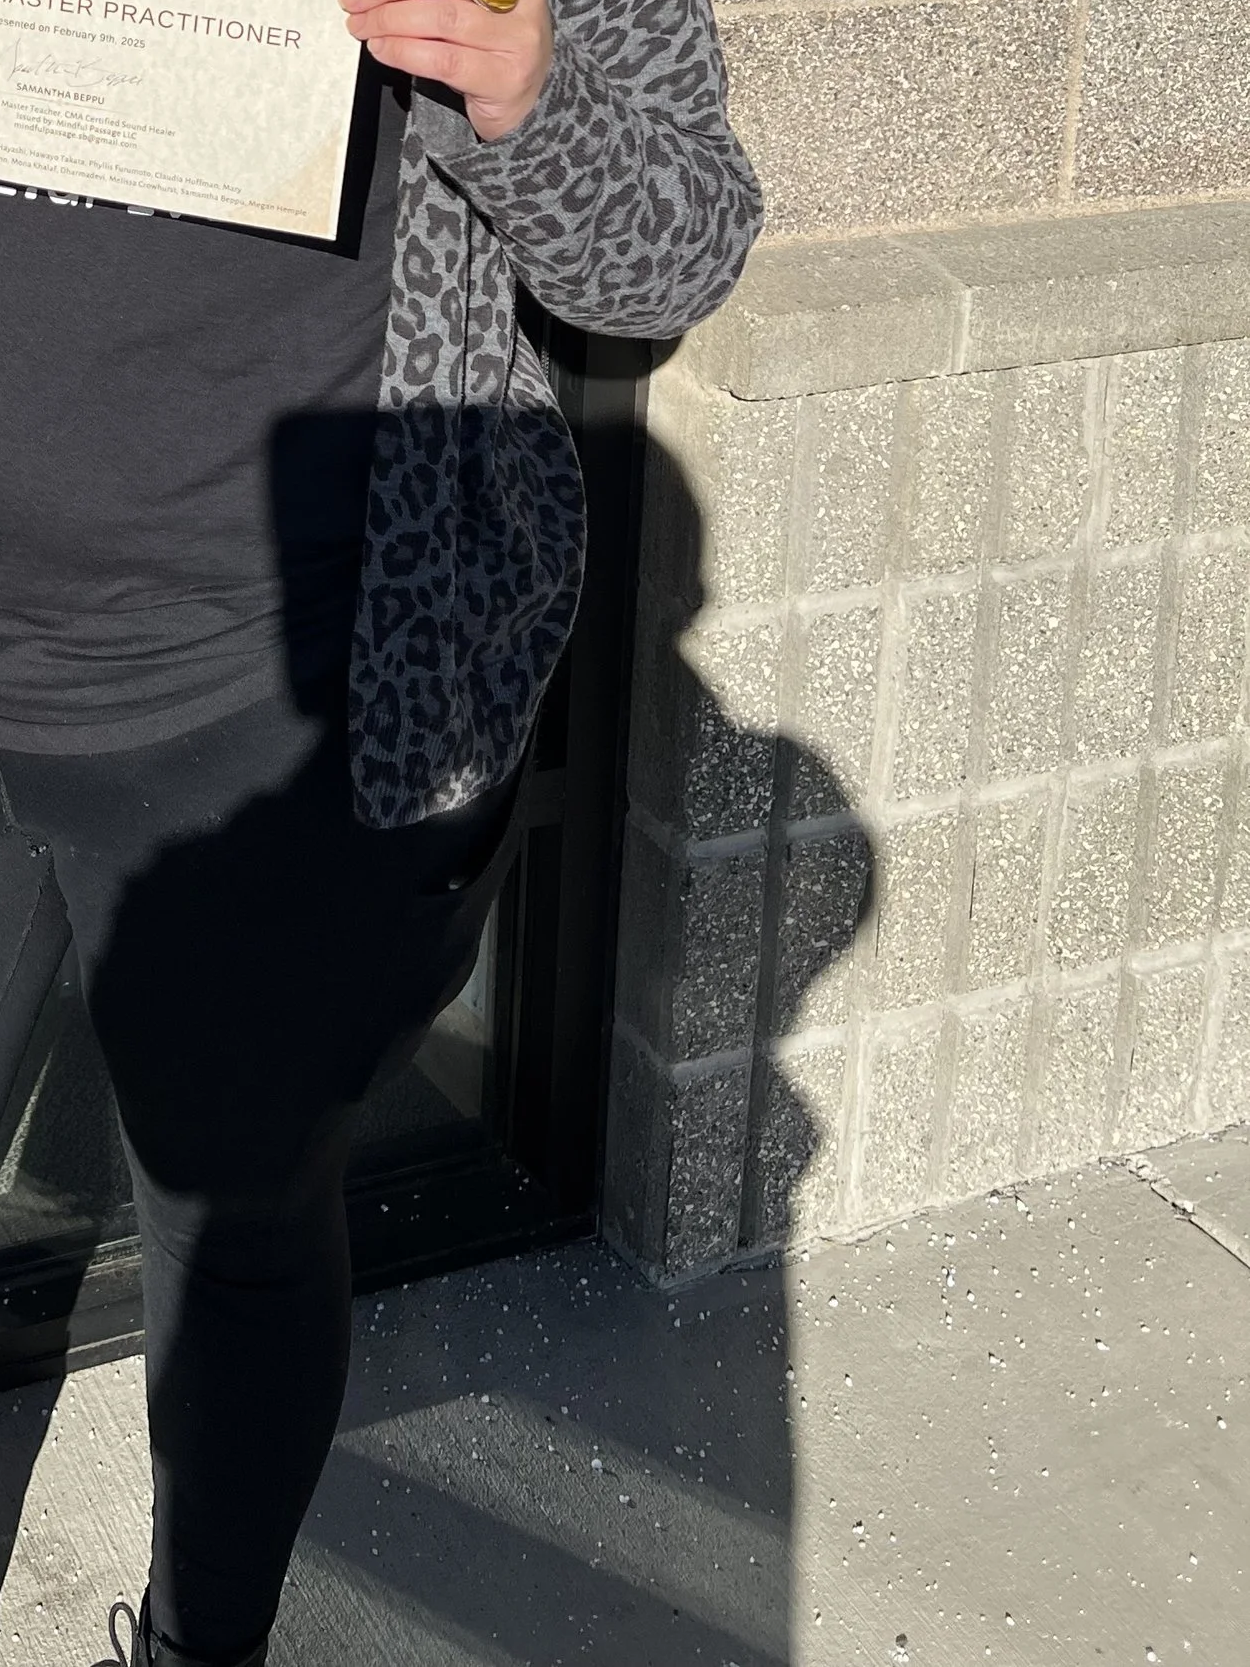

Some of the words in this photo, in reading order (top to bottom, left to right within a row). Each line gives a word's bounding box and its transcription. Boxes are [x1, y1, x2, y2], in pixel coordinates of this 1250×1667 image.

[38, 24, 50, 34] on
[53, 26, 97, 42] February
[99, 34, 118, 45] 9th,
[120, 37, 146, 49] 2025
[103, 1, 302, 50] PRACTITIONER
[16, 83, 71, 100] SAMANTHA
[73, 93, 105, 105] BEPPU
[1, 99, 29, 112] Master
[64, 110, 84, 121] CMA
[85, 113, 120, 128] Certified
[121, 121, 147, 133] Sound
[148, 125, 176, 137] Healer
[16, 112, 41, 124] Issued
[56, 118, 88, 132] Mindful
[89, 123, 121, 138] Passage
[123, 130, 138, 141] LLC
[10, 156, 32, 168] Mona
[109, 174, 138, 187] Melissa
[180, 188, 219, 202] Samantha
[249, 200, 276, 212] Megan
[277, 205, 308, 218] Hemple
[30, 148, 60, 161] Hawayo
[88, 159, 113, 172] Phyllis
[154, 171, 183, 183] Claudia
[222, 184, 243, 195] Mary
